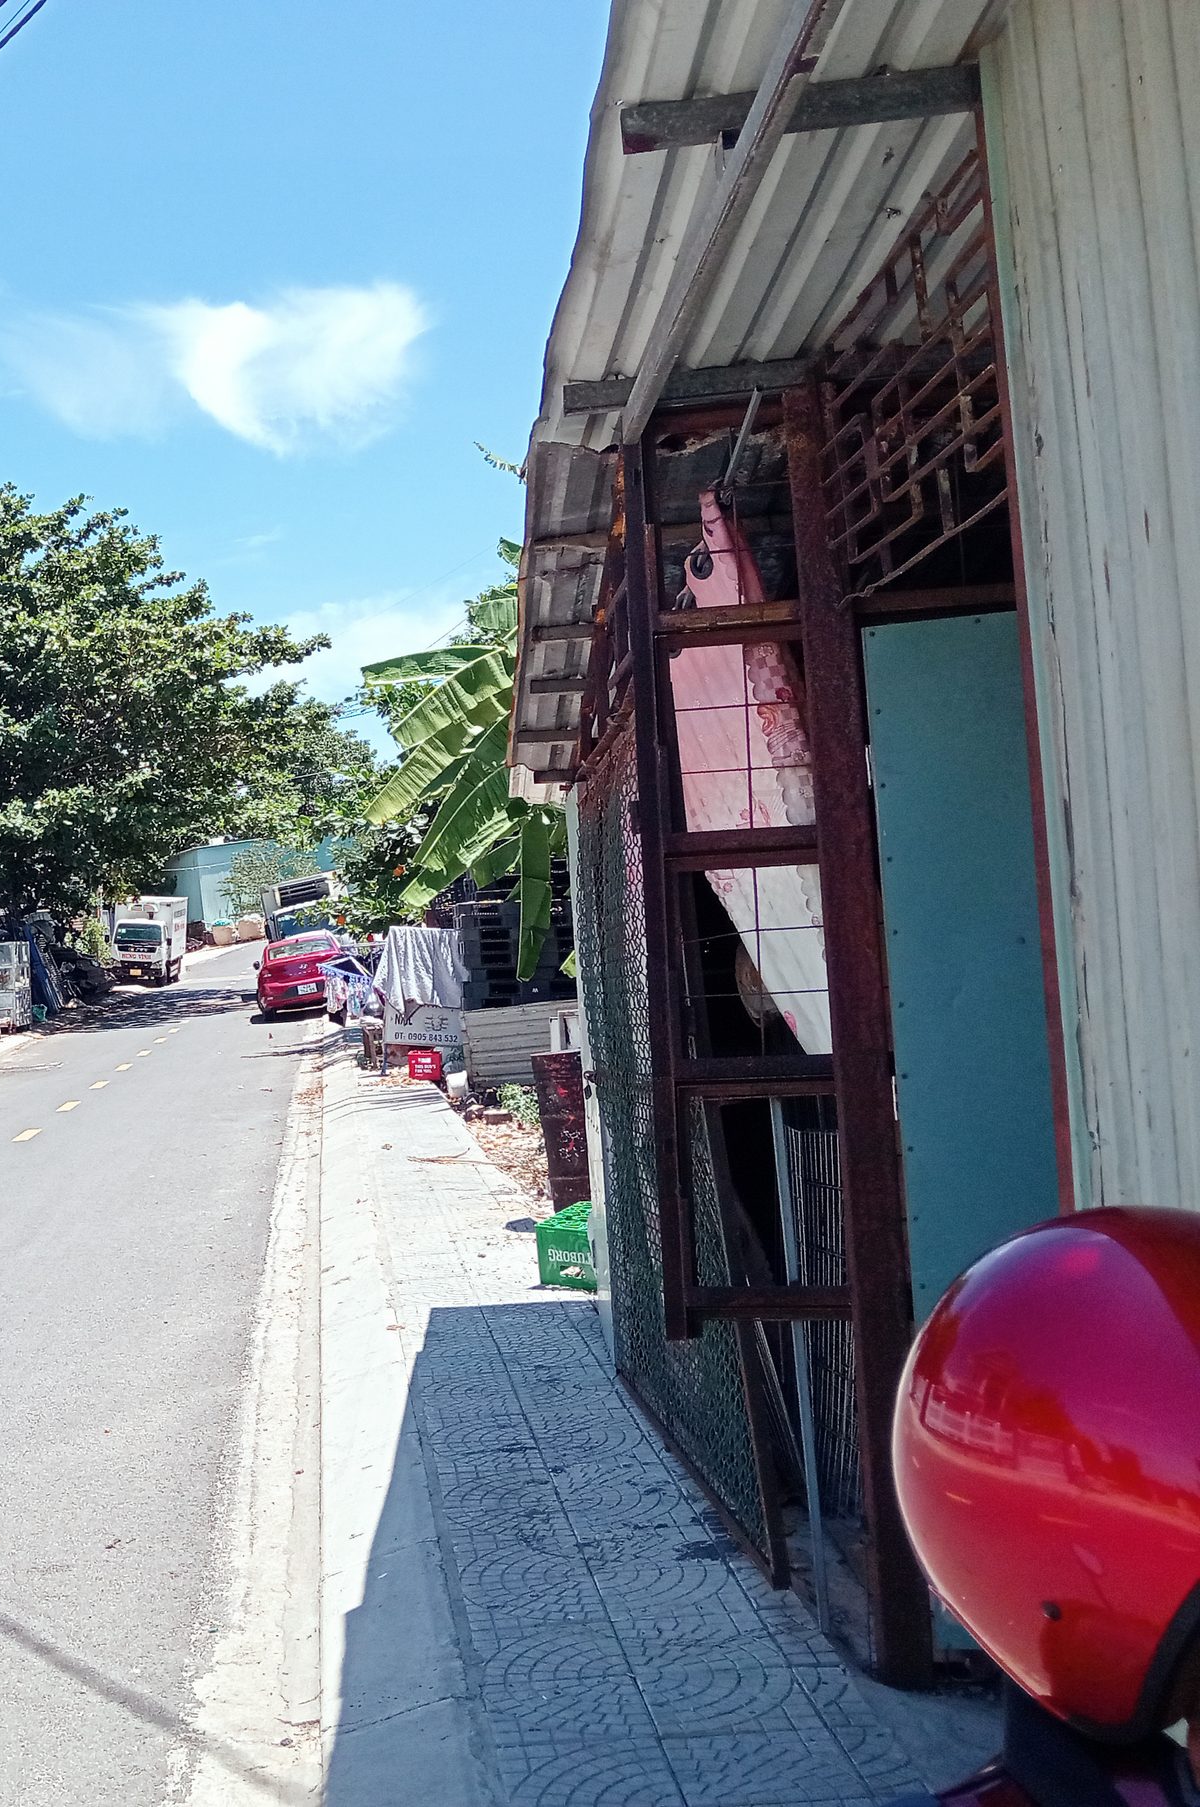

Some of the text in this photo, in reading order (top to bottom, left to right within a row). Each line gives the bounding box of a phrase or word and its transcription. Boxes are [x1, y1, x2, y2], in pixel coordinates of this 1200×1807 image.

[407, 1032, 427, 1041] 0905
[428, 1034, 443, 1042] 843
[444, 1034, 458, 1043] 532
[548, 1248, 592, 1264] TUBORG
